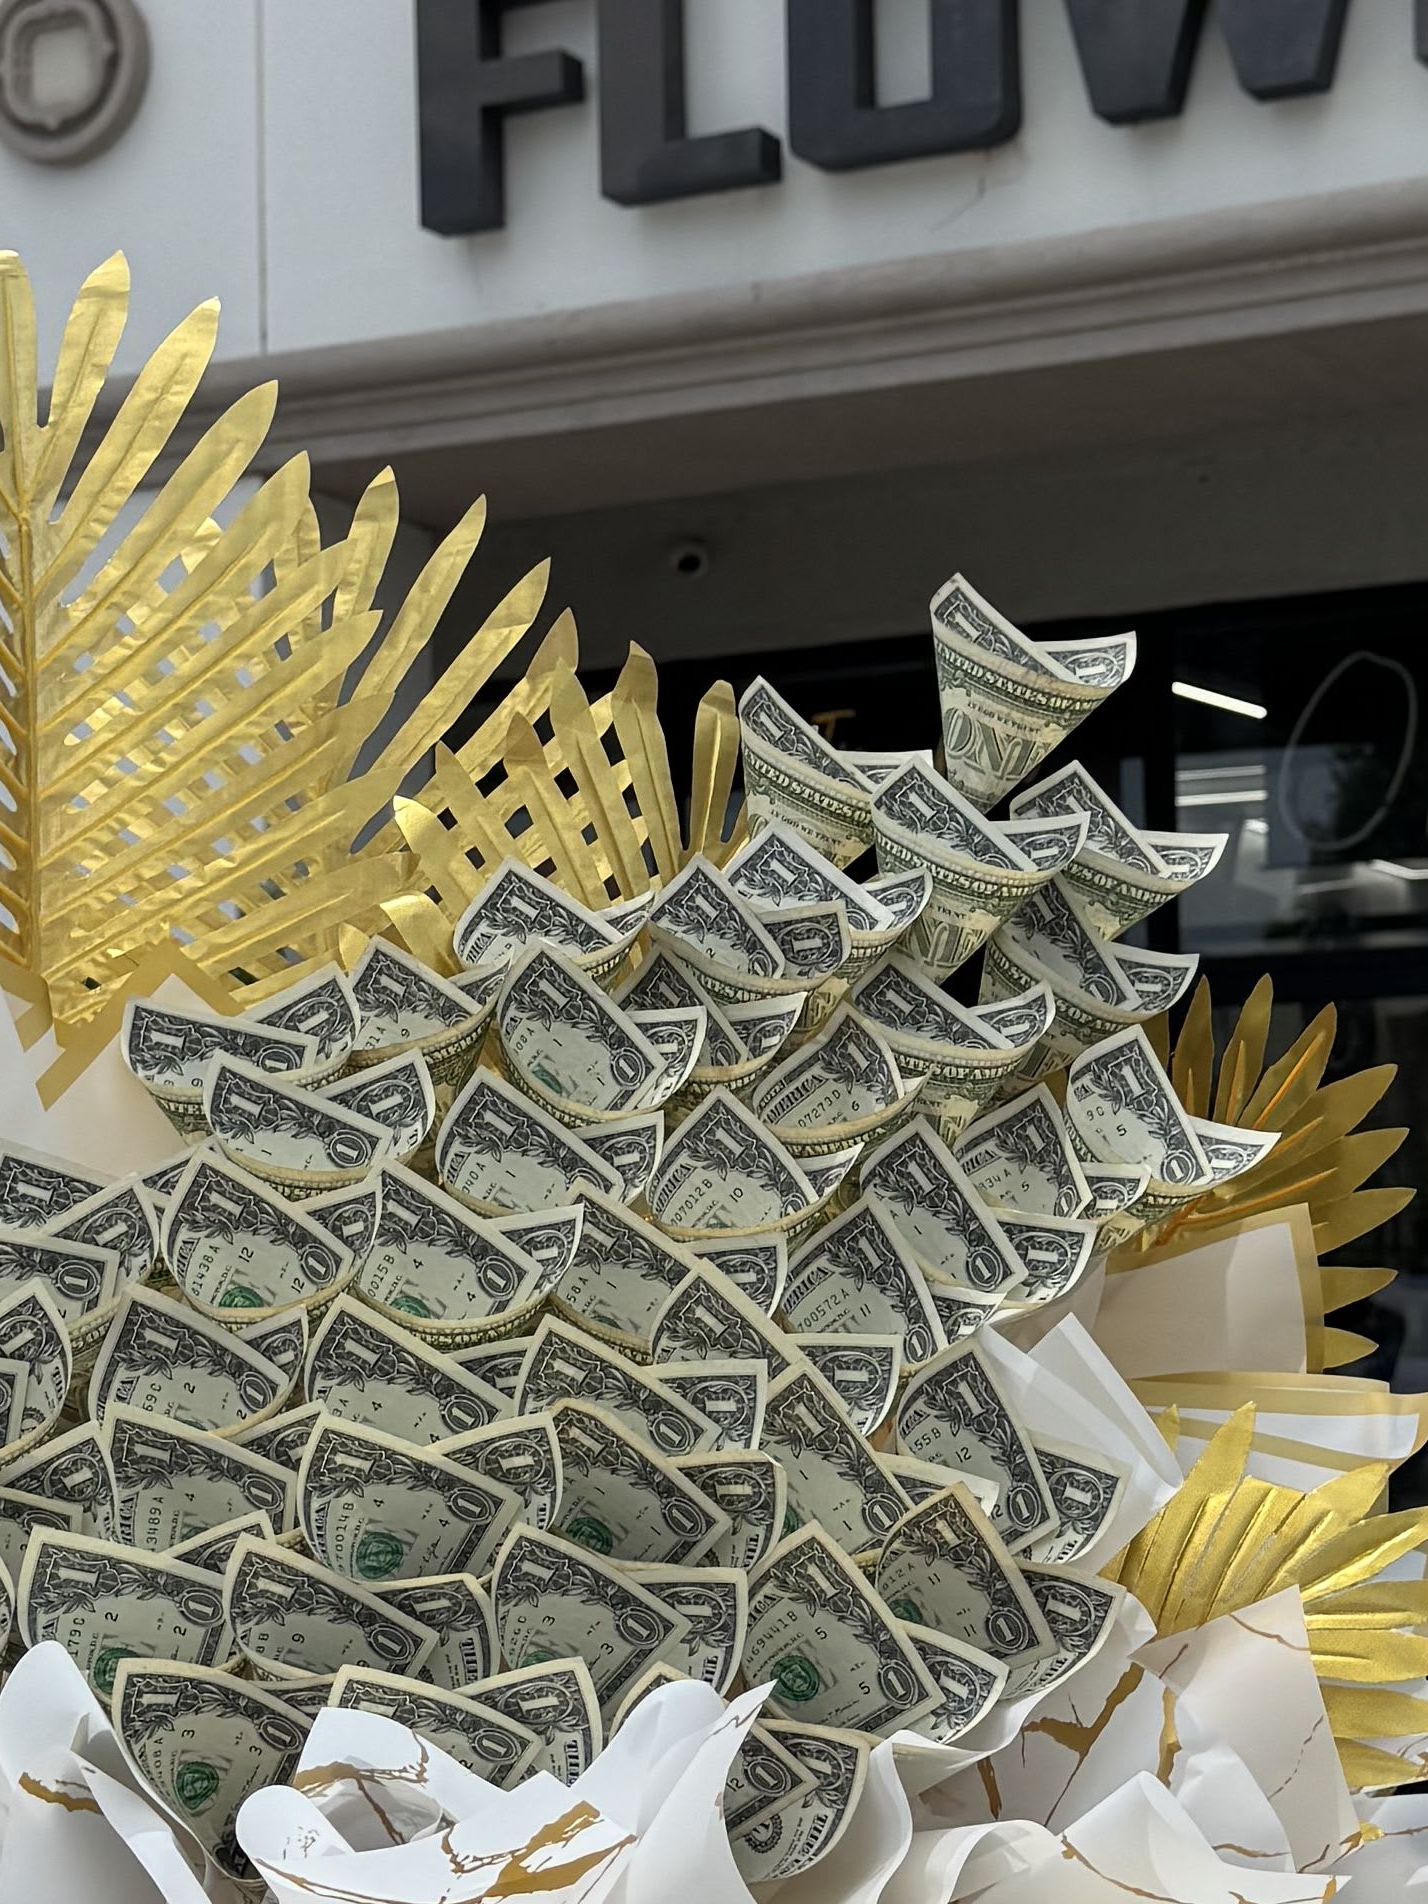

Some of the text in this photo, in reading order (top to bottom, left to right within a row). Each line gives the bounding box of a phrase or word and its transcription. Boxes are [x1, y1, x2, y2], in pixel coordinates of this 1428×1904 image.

[954, 613, 982, 644] 1
[760, 711, 785, 742] 1
[788, 778, 854, 818] STATES
[908, 792, 937, 824] 1
[771, 858, 799, 886] 1
[510, 898, 541, 921] 1
[695, 894, 719, 919] 1
[1032, 897, 1056, 925] 1
[380, 974, 407, 996] 1
[538, 980, 570, 1014] 1
[885, 987, 917, 1017] 1
[295, 1010, 329, 1034] 1
[149, 1030, 186, 1050] 1
[846, 1044, 870, 1074] 1
[1119, 1063, 1147, 1097] 1
[230, 1096, 264, 1117] 1
[371, 1093, 404, 1114] 1
[850, 1099, 860, 1112] 6
[483, 1108, 518, 1139] 1
[1115, 1124, 1128, 1138] 5
[715, 1126, 746, 1159] 1
[1025, 1122, 1049, 1152] 1
[335, 1142, 360, 1162] 1
[907, 1160, 939, 1197] 1
[1019, 1180, 1031, 1193] 5
[16, 1182, 55, 1205] 1
[730, 1186, 744, 1202] 10
[209, 1192, 244, 1221] 1
[386, 1198, 422, 1228] 1
[91, 1219, 129, 1246] 1
[340, 1220, 365, 1238] 1
[582, 1222, 618, 1248] 1
[238, 1246, 255, 1263] 12
[857, 1234, 883, 1269] 1
[1027, 1248, 1060, 1264] 1
[412, 1257, 424, 1270] 4
[290, 1277, 305, 1294] 12
[486, 1268, 508, 1289] 1
[466, 1291, 477, 1303] 4
[694, 1304, 728, 1338] 1
[858, 1303, 872, 1318] 11
[144, 1328, 180, 1353] 1
[344, 1337, 382, 1367] 1
[553, 1357, 590, 1385] 1
[831, 1369, 869, 1383] 1
[184, 1381, 196, 1394] 2
[956, 1380, 986, 1416] 1
[236, 1408, 248, 1420] 2
[370, 1399, 383, 1412] 4
[705, 1398, 738, 1413] 1
[450, 1407, 474, 1427] 1
[794, 1402, 826, 1440] 1
[569, 1424, 606, 1454] 1
[134, 1442, 172, 1465] 1
[334, 1452, 374, 1474] 1
[497, 1454, 536, 1473] 1
[954, 1446, 971, 1464] 12
[61, 1468, 93, 1490] 1
[184, 1492, 195, 1502] 4
[714, 1483, 753, 1497] 1
[1062, 1485, 1093, 1507] 1
[373, 1497, 385, 1508] 4
[440, 1517, 451, 1528] 4
[670, 1508, 694, 1530] 1
[873, 1506, 894, 1530] 1
[936, 1519, 961, 1547] 1
[58, 1566, 101, 1587] 1
[522, 1558, 556, 1584] 1
[805, 1560, 841, 1598] 1
[927, 1573, 941, 1586] 11
[254, 1577, 298, 1601] 1
[411, 1598, 454, 1613] 1
[674, 1604, 713, 1617] 1
[1044, 1597, 1084, 1622] 1
[105, 1611, 119, 1623] 2
[542, 1614, 556, 1626] 3
[173, 1625, 187, 1637] 2
[293, 1632, 305, 1644] 9
[627, 1618, 650, 1638] 1
[814, 1626, 829, 1641] 5
[962, 1624, 978, 1638] 11
[995, 1618, 1015, 1642] 1
[378, 1634, 404, 1653] 1
[600, 1642, 614, 1655] 3
[858, 1680, 872, 1695] 5
[886, 1670, 907, 1692] 1
[939, 1671, 970, 1695] 1
[140, 1693, 181, 1708] 1
[518, 1696, 560, 1715] 1
[181, 1727, 196, 1739] 3
[249, 1744, 263, 1756] 3
[480, 1738, 507, 1757] 1
[754, 1765, 778, 1788] 1
